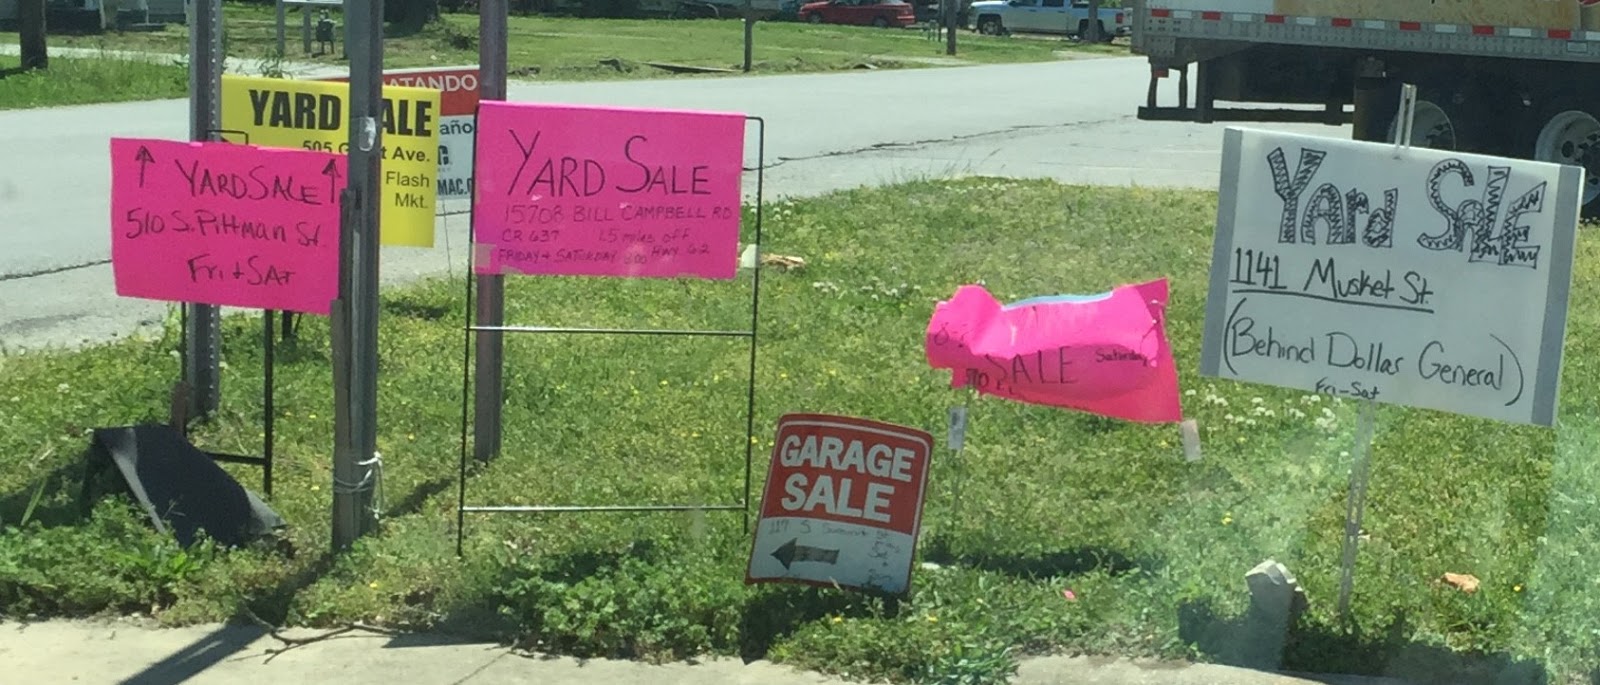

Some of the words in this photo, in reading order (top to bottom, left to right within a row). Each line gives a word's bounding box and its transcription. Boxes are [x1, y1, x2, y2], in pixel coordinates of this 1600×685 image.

[383, 74, 478, 91] ATANDO
[249, 89, 342, 131] YARD
[381, 98, 432, 137] ALE
[392, 147, 430, 161] Ave.
[508, 129, 605, 197] YARD
[616, 135, 711, 195] SALE
[386, 171, 430, 187] Flash
[395, 193, 428, 208] Mkt.
[573, 205, 613, 222] BILL
[621, 204, 706, 220] CAMPBELL
[712, 206, 732, 219] RD
[126, 208, 165, 239] 510
[502, 228, 522, 242] CR
[1230, 247, 1287, 290] 1141
[1304, 257, 1394, 299] Musket
[1400, 271, 1434, 305] St.
[985, 346, 1079, 385] SALE
[1326, 332, 1404, 375] Dollar
[780, 435, 915, 482] GARAGE
[781, 473, 895, 523] SALE
